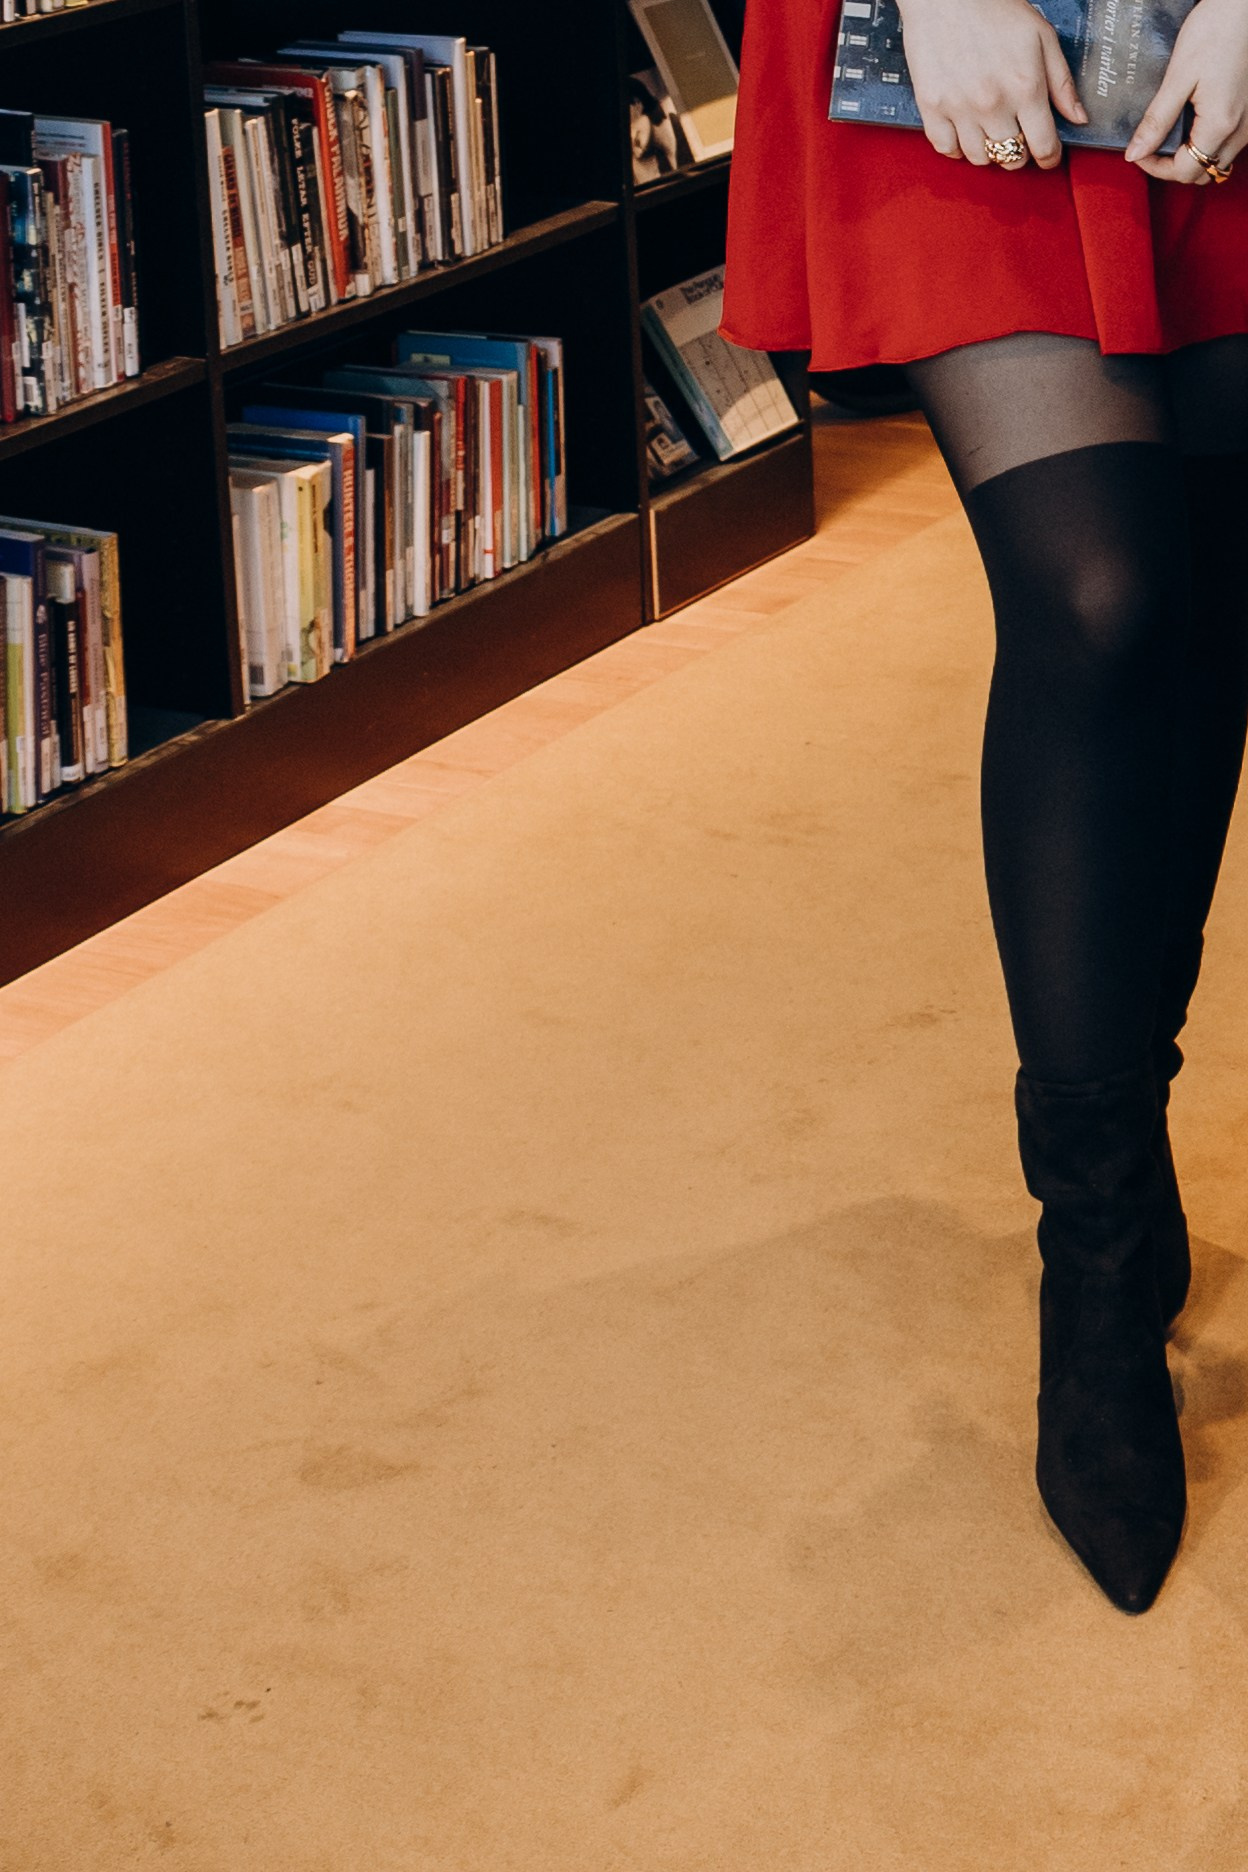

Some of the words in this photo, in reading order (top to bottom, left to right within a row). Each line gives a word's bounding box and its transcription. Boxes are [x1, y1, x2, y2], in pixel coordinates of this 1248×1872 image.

[1125, 42, 1140, 85] ZWEIG
[323, 85, 337, 141] CHUCK
[290, 118, 303, 159] FOLKE
[295, 166, 308, 207] LETAR
[329, 145, 349, 241] PALAHNIUK
[300, 213, 313, 255] EFTER
[305, 260, 316, 286] GUD
[342, 469, 354, 533] HUNTER
[37, 633, 49, 667] Blue
[38, 671, 51, 735] Pastoral
